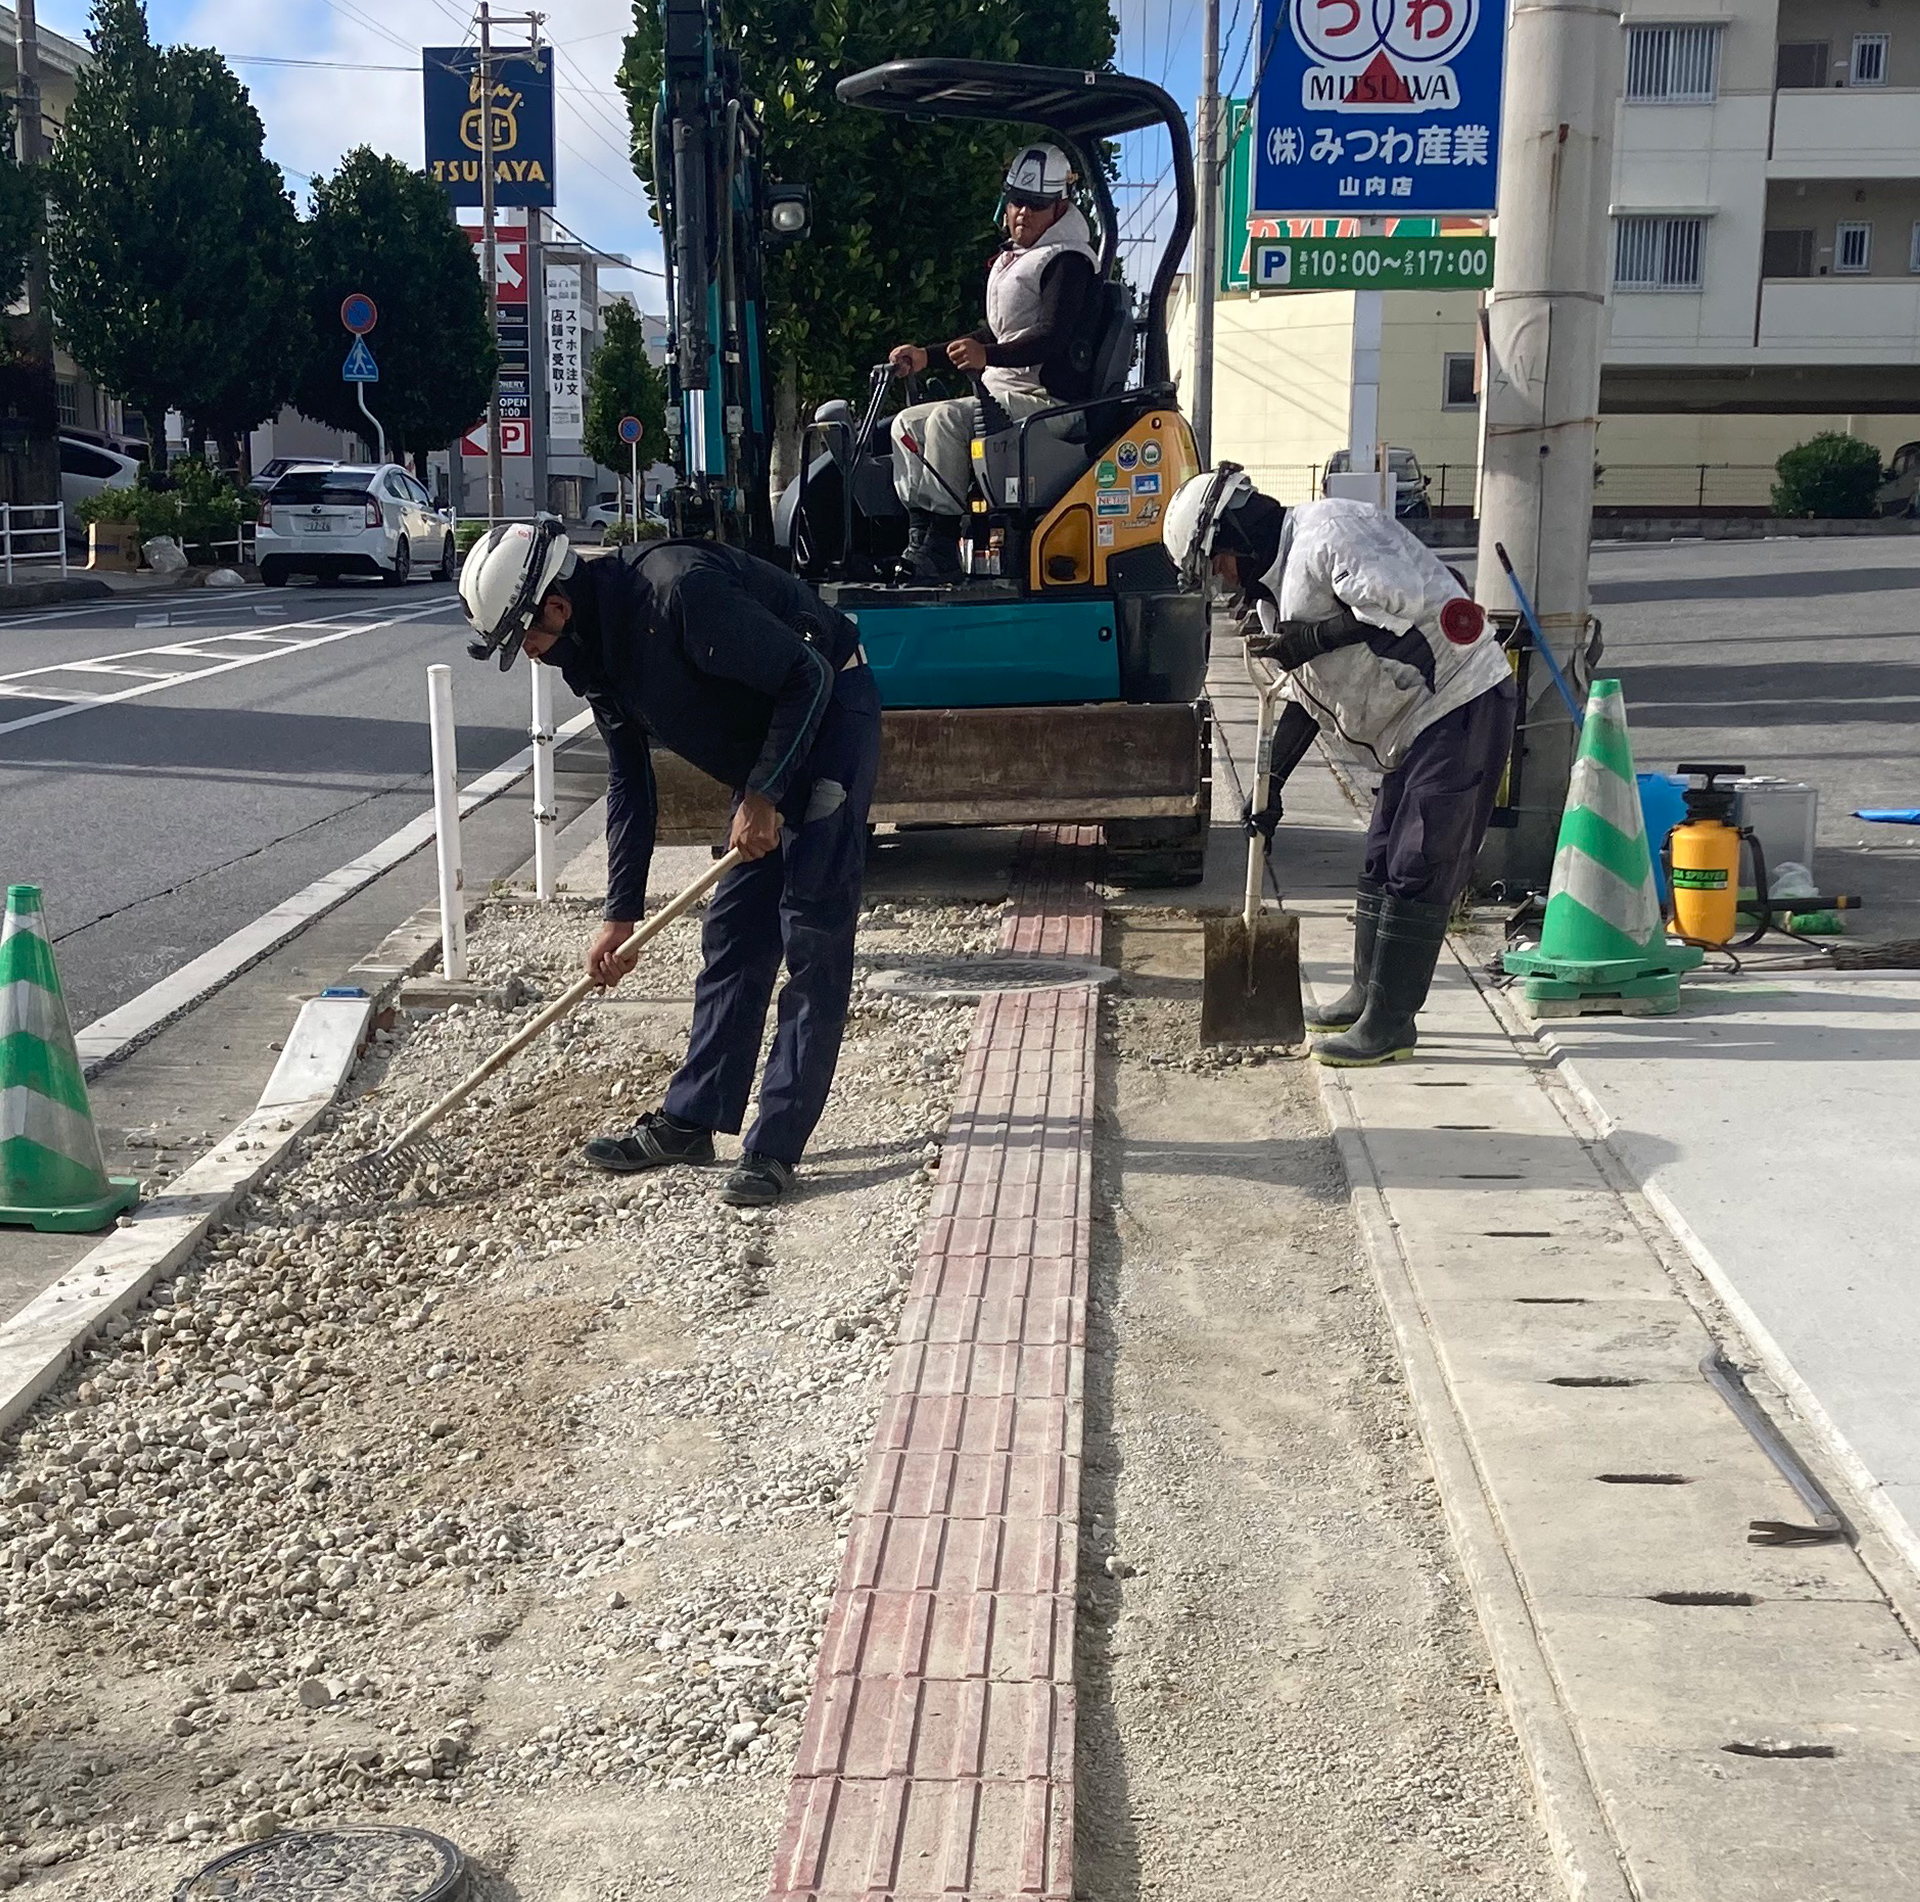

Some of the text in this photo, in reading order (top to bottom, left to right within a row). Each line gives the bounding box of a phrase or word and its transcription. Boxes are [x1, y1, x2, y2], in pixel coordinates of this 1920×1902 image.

[1310, 75, 1450, 101] MITSUWA
[433, 160, 546, 182] TSUAYA
[1339, 177, 1413, 196] 山内店
[1263, 250, 1287, 278] P
[551, 308, 565, 395] 店舗で受取り
[566, 309, 579, 396] スマホで注文
[499, 398, 527, 407] OPEN
[502, 426, 520, 449] P
